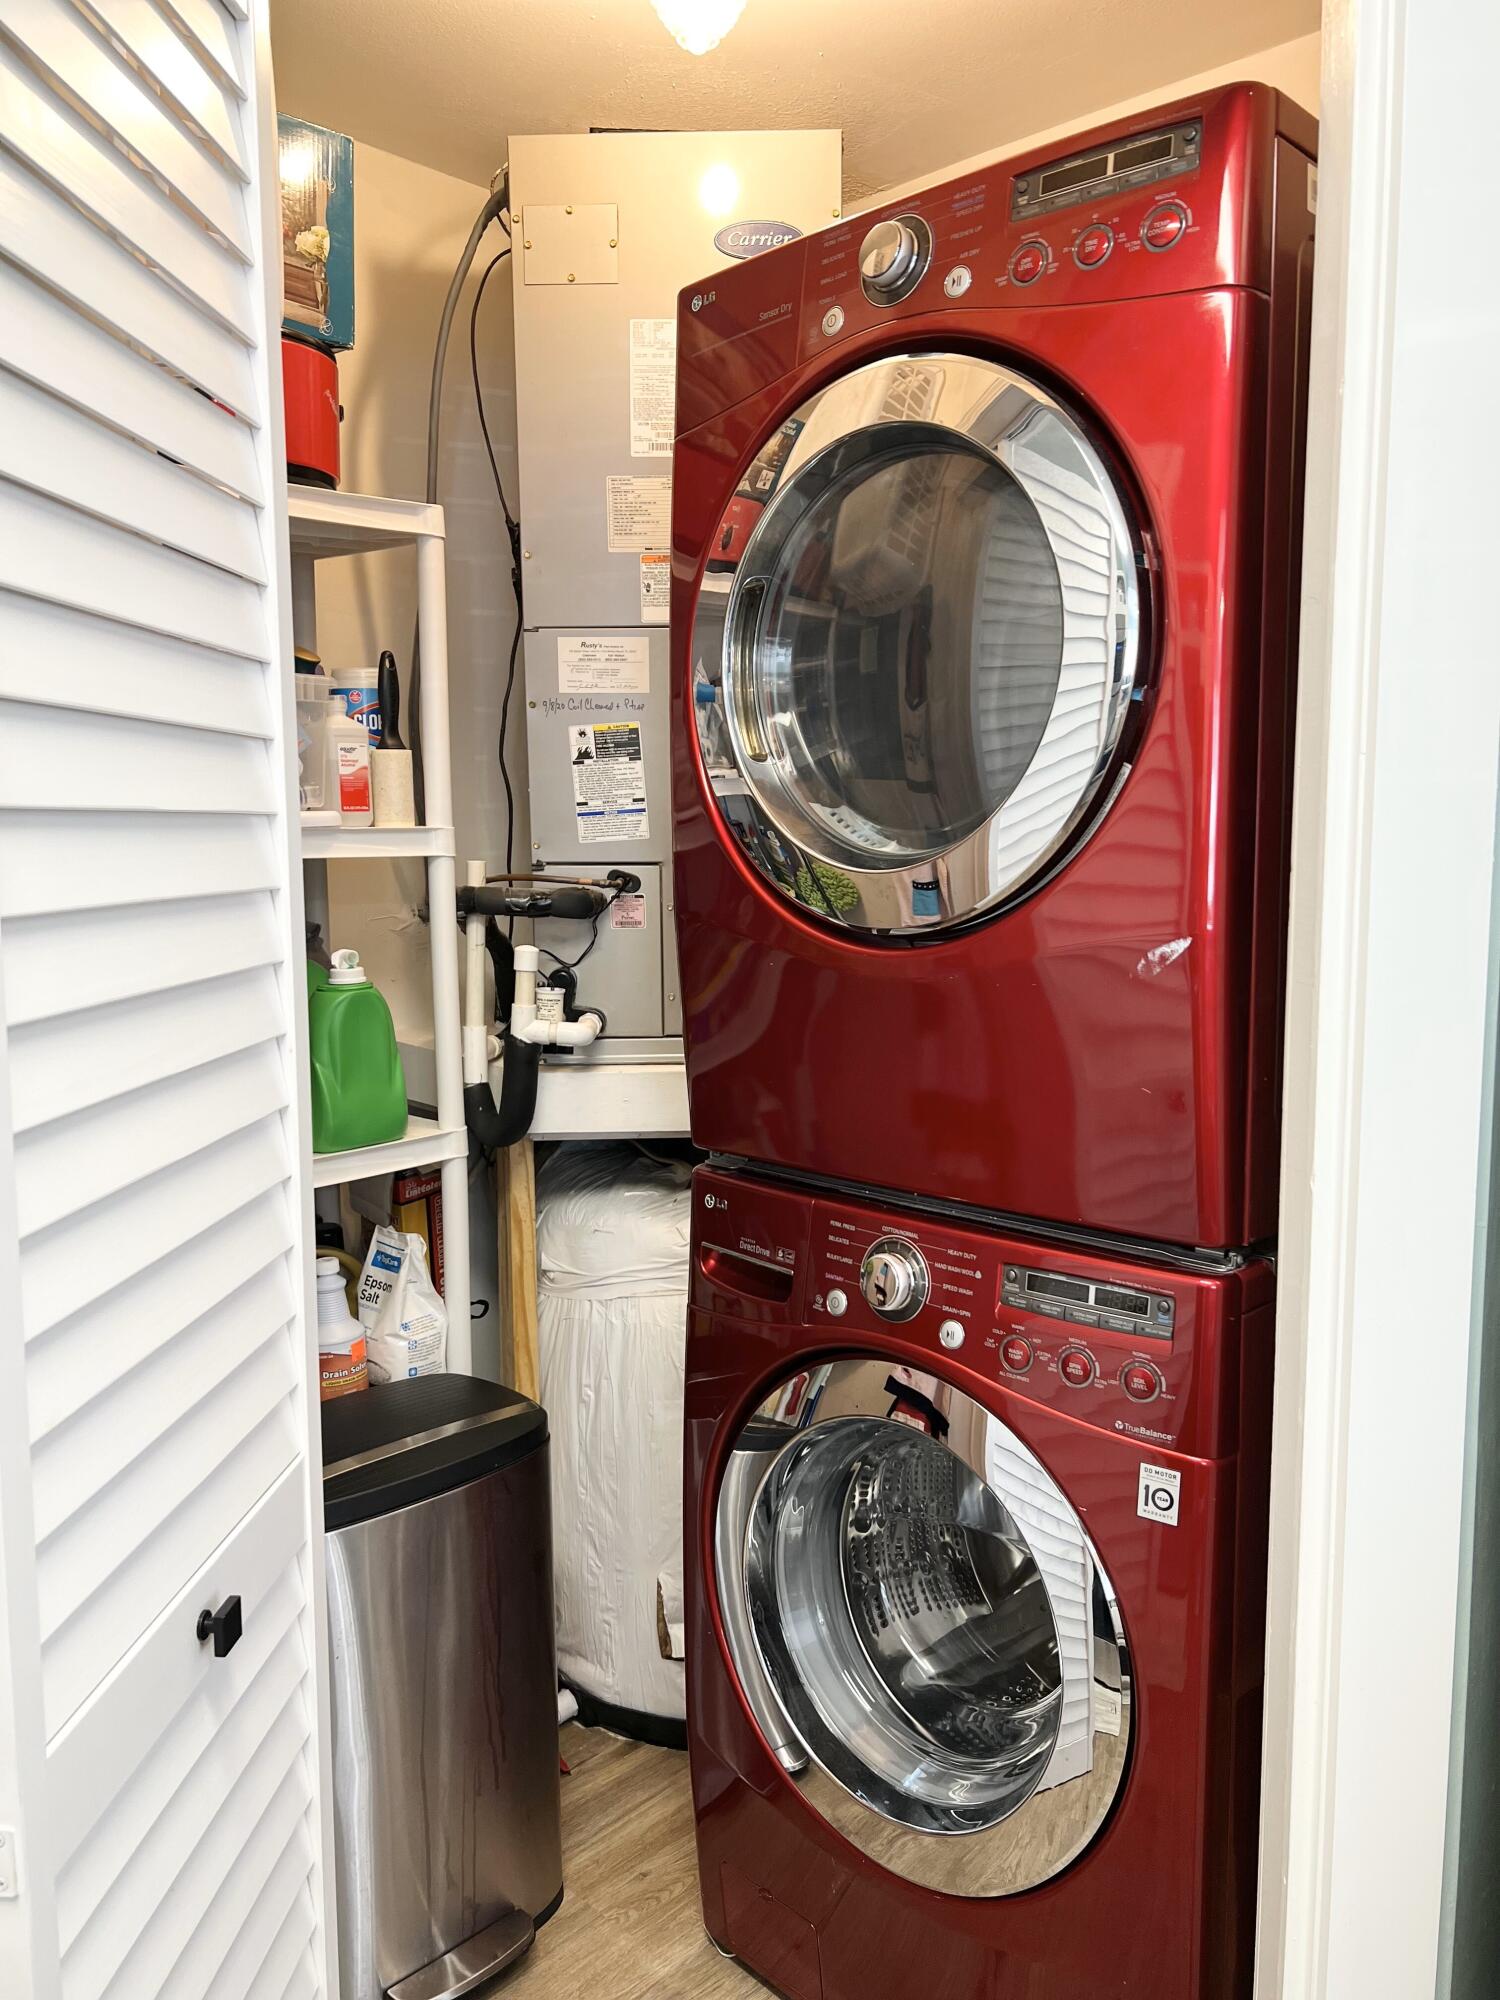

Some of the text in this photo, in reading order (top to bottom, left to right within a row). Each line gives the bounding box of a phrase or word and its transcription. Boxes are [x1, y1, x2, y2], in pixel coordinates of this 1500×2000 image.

[728, 231, 793, 247] Carrier
[758, 302, 793, 322] Sensor Dry
[580, 641, 603, 650] Rusty's
[567, 697, 583, 711] Coil
[739, 1240, 770, 1257] Direct Drive
[364, 1274, 393, 1294] Epsom
[360, 1288, 380, 1305] Salt
[322, 1369, 349, 1379] Drain
[1124, 1422, 1173, 1441] TrueBalance
[1144, 1466, 1178, 1481] DD MOTOR
[1143, 1483, 1175, 1512] 10
[1143, 1508, 1174, 1520] WARRANTY
